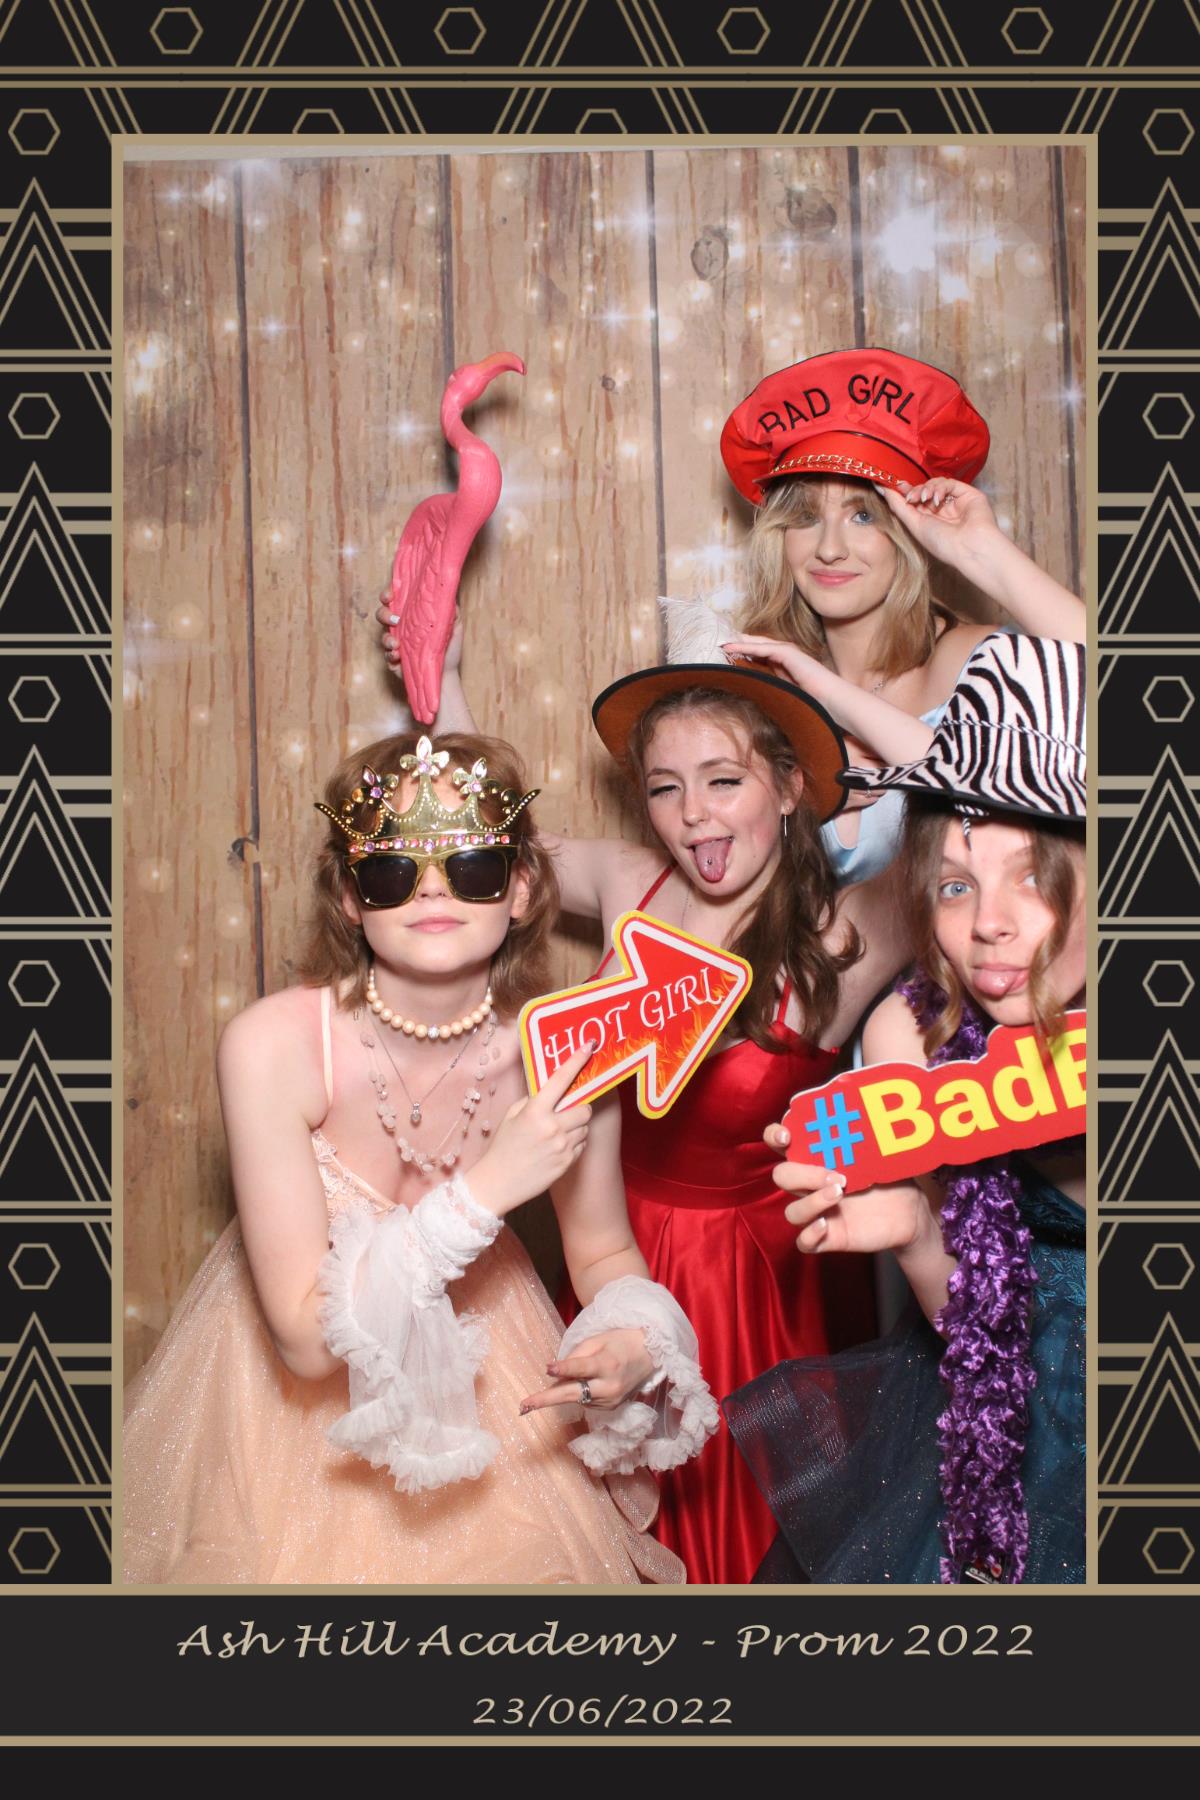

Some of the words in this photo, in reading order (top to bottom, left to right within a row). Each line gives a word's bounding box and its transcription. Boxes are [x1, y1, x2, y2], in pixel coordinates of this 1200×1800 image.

[758, 387, 831, 434] BAD
[848, 374, 915, 424] GIRL
[544, 1001, 630, 1071] HOT
[639, 966, 725, 1031] GIRL
